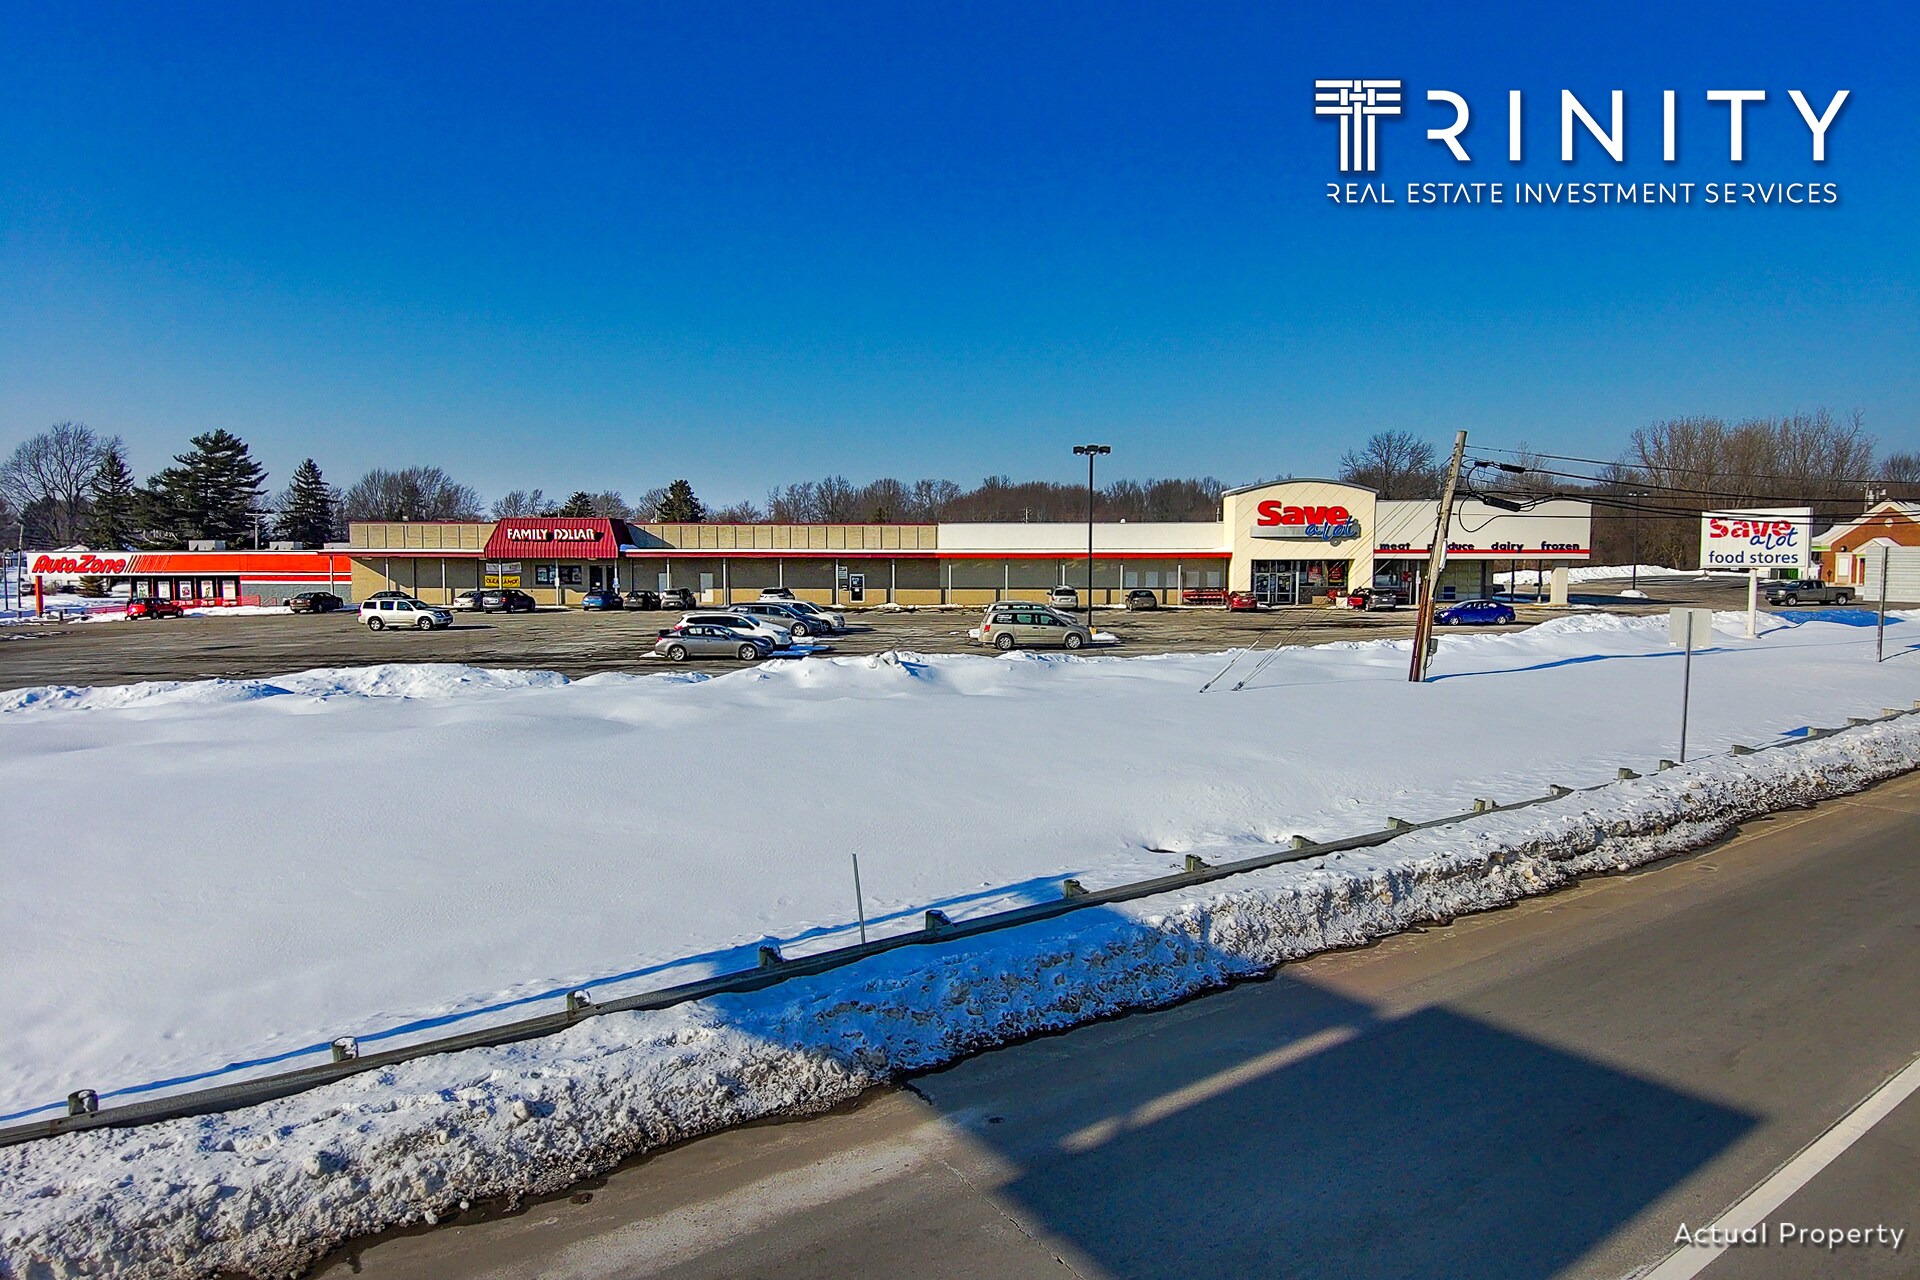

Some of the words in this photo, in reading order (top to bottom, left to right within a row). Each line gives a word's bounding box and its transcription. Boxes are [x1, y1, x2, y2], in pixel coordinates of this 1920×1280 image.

[1257, 500, 1349, 526] Save
[507, 528, 548, 540] FAMILY
[553, 528, 595, 540] DOLLAR
[1709, 517, 1792, 538] Save
[1379, 541, 1411, 551] meat
[1427, 542, 1475, 552] pduce
[1490, 541, 1524, 553] dairy
[1541, 541, 1580, 551] frozen
[32, 555, 126, 573] AutoZone
[1709, 550, 1744, 563] food
[1750, 552, 1798, 563] stores
